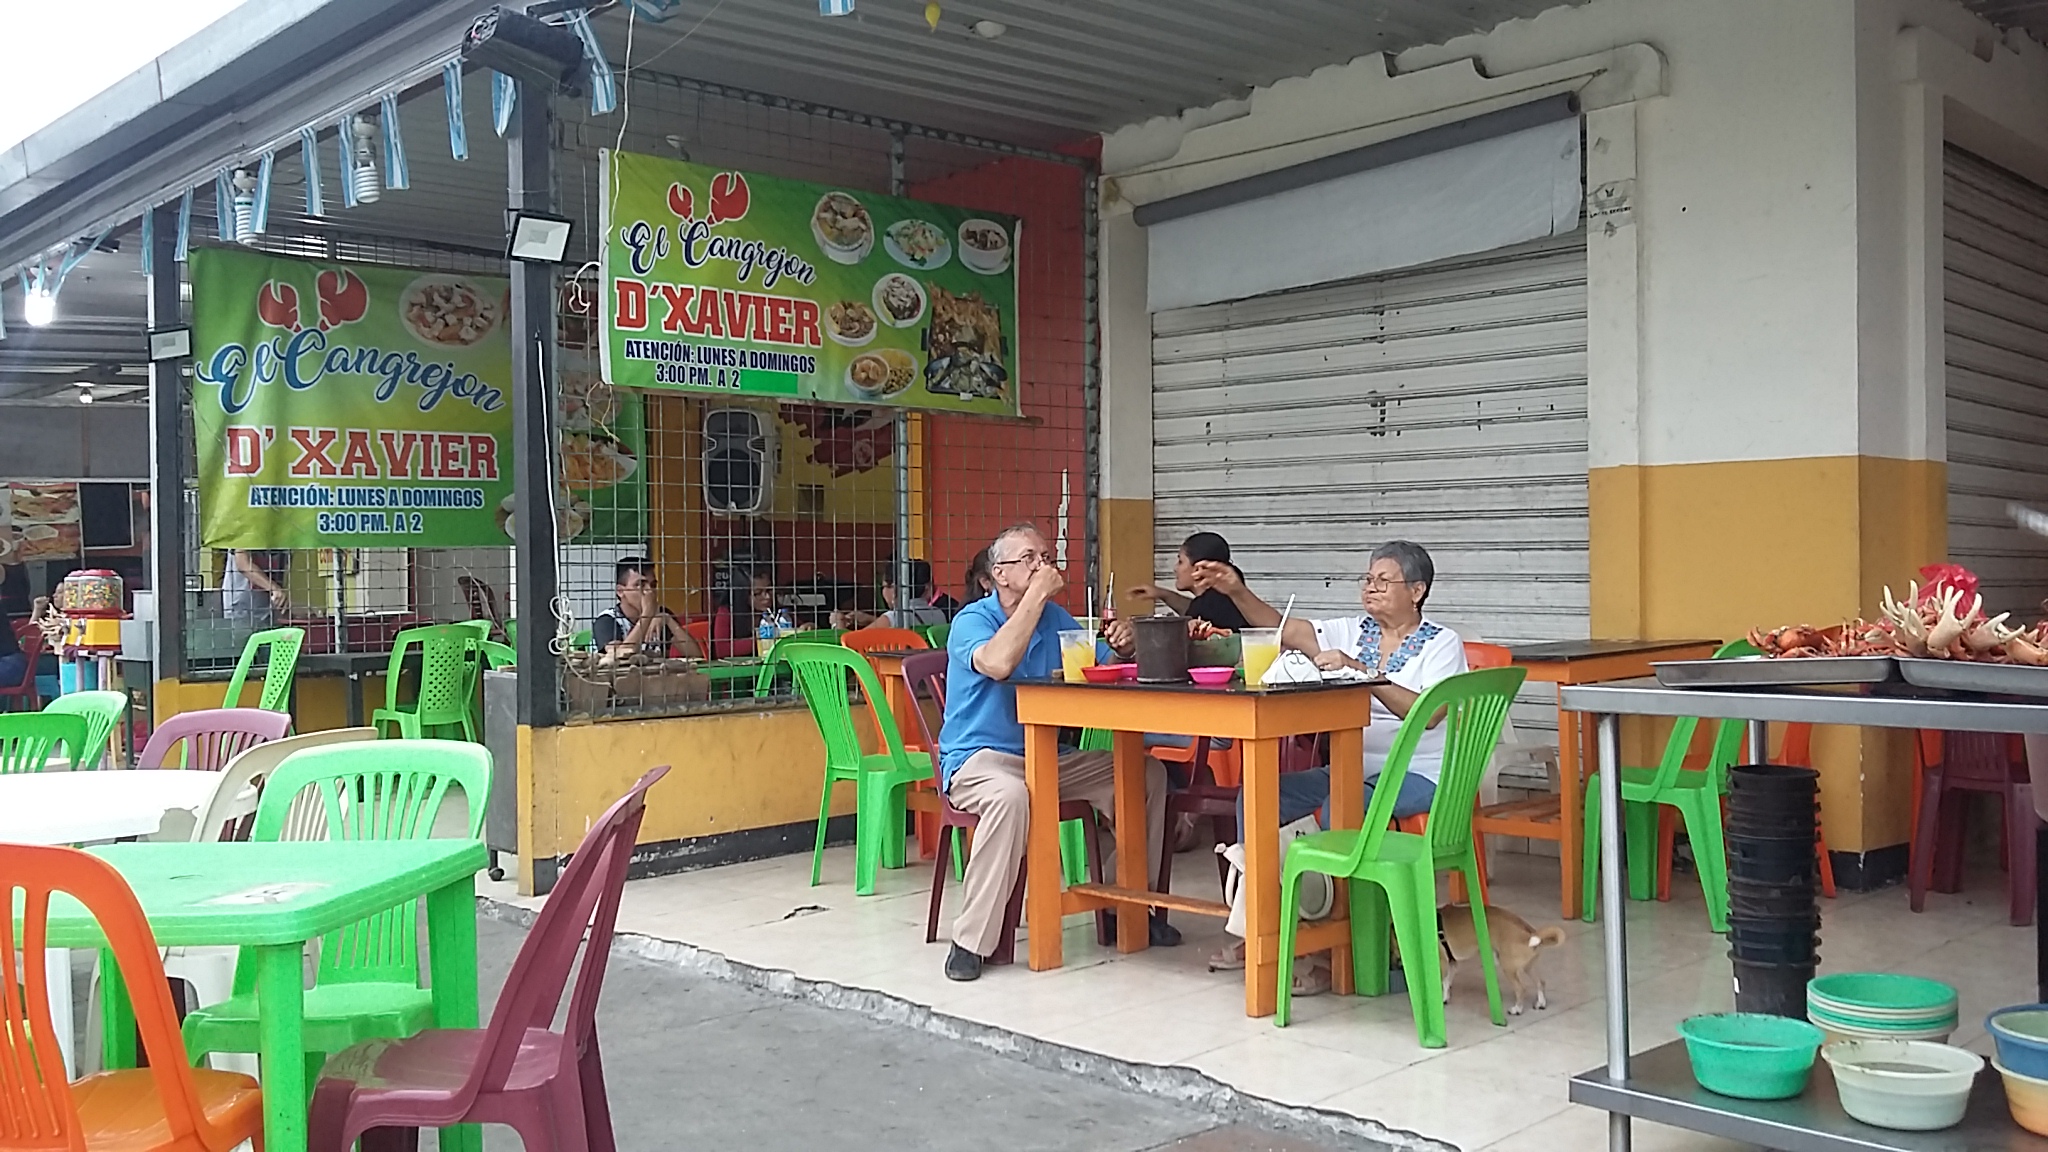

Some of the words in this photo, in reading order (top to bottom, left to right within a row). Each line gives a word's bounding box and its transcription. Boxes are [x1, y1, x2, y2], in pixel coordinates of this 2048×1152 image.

[620, 220, 670, 275] El
[679, 220, 816, 288] Cangrejon
[196, 343, 278, 415] El
[273, 327, 504, 412] Cangrejon
[625, 339, 695, 364] ATENCIÓN:
[697, 345, 736, 368] LUNES
[738, 349, 748, 369] A
[750, 350, 816, 375] DOMINGOS
[656, 363, 686, 384] 3:00
[689, 366, 712, 387] PM.
[717, 368, 727, 388] A
[731, 369, 741, 389] 2
[290, 429, 499, 480] XAVIER
[250, 484, 335, 507] ATENCIÓN:
[337, 487, 386, 508] LUNES
[388, 488, 401, 507] A
[402, 487, 484, 509] DOMINGOS
[318, 512, 357, 533] 3:00
[360, 512, 389, 533] PM.
[395, 512, 406, 533] A
[411, 513, 423, 533] 2
